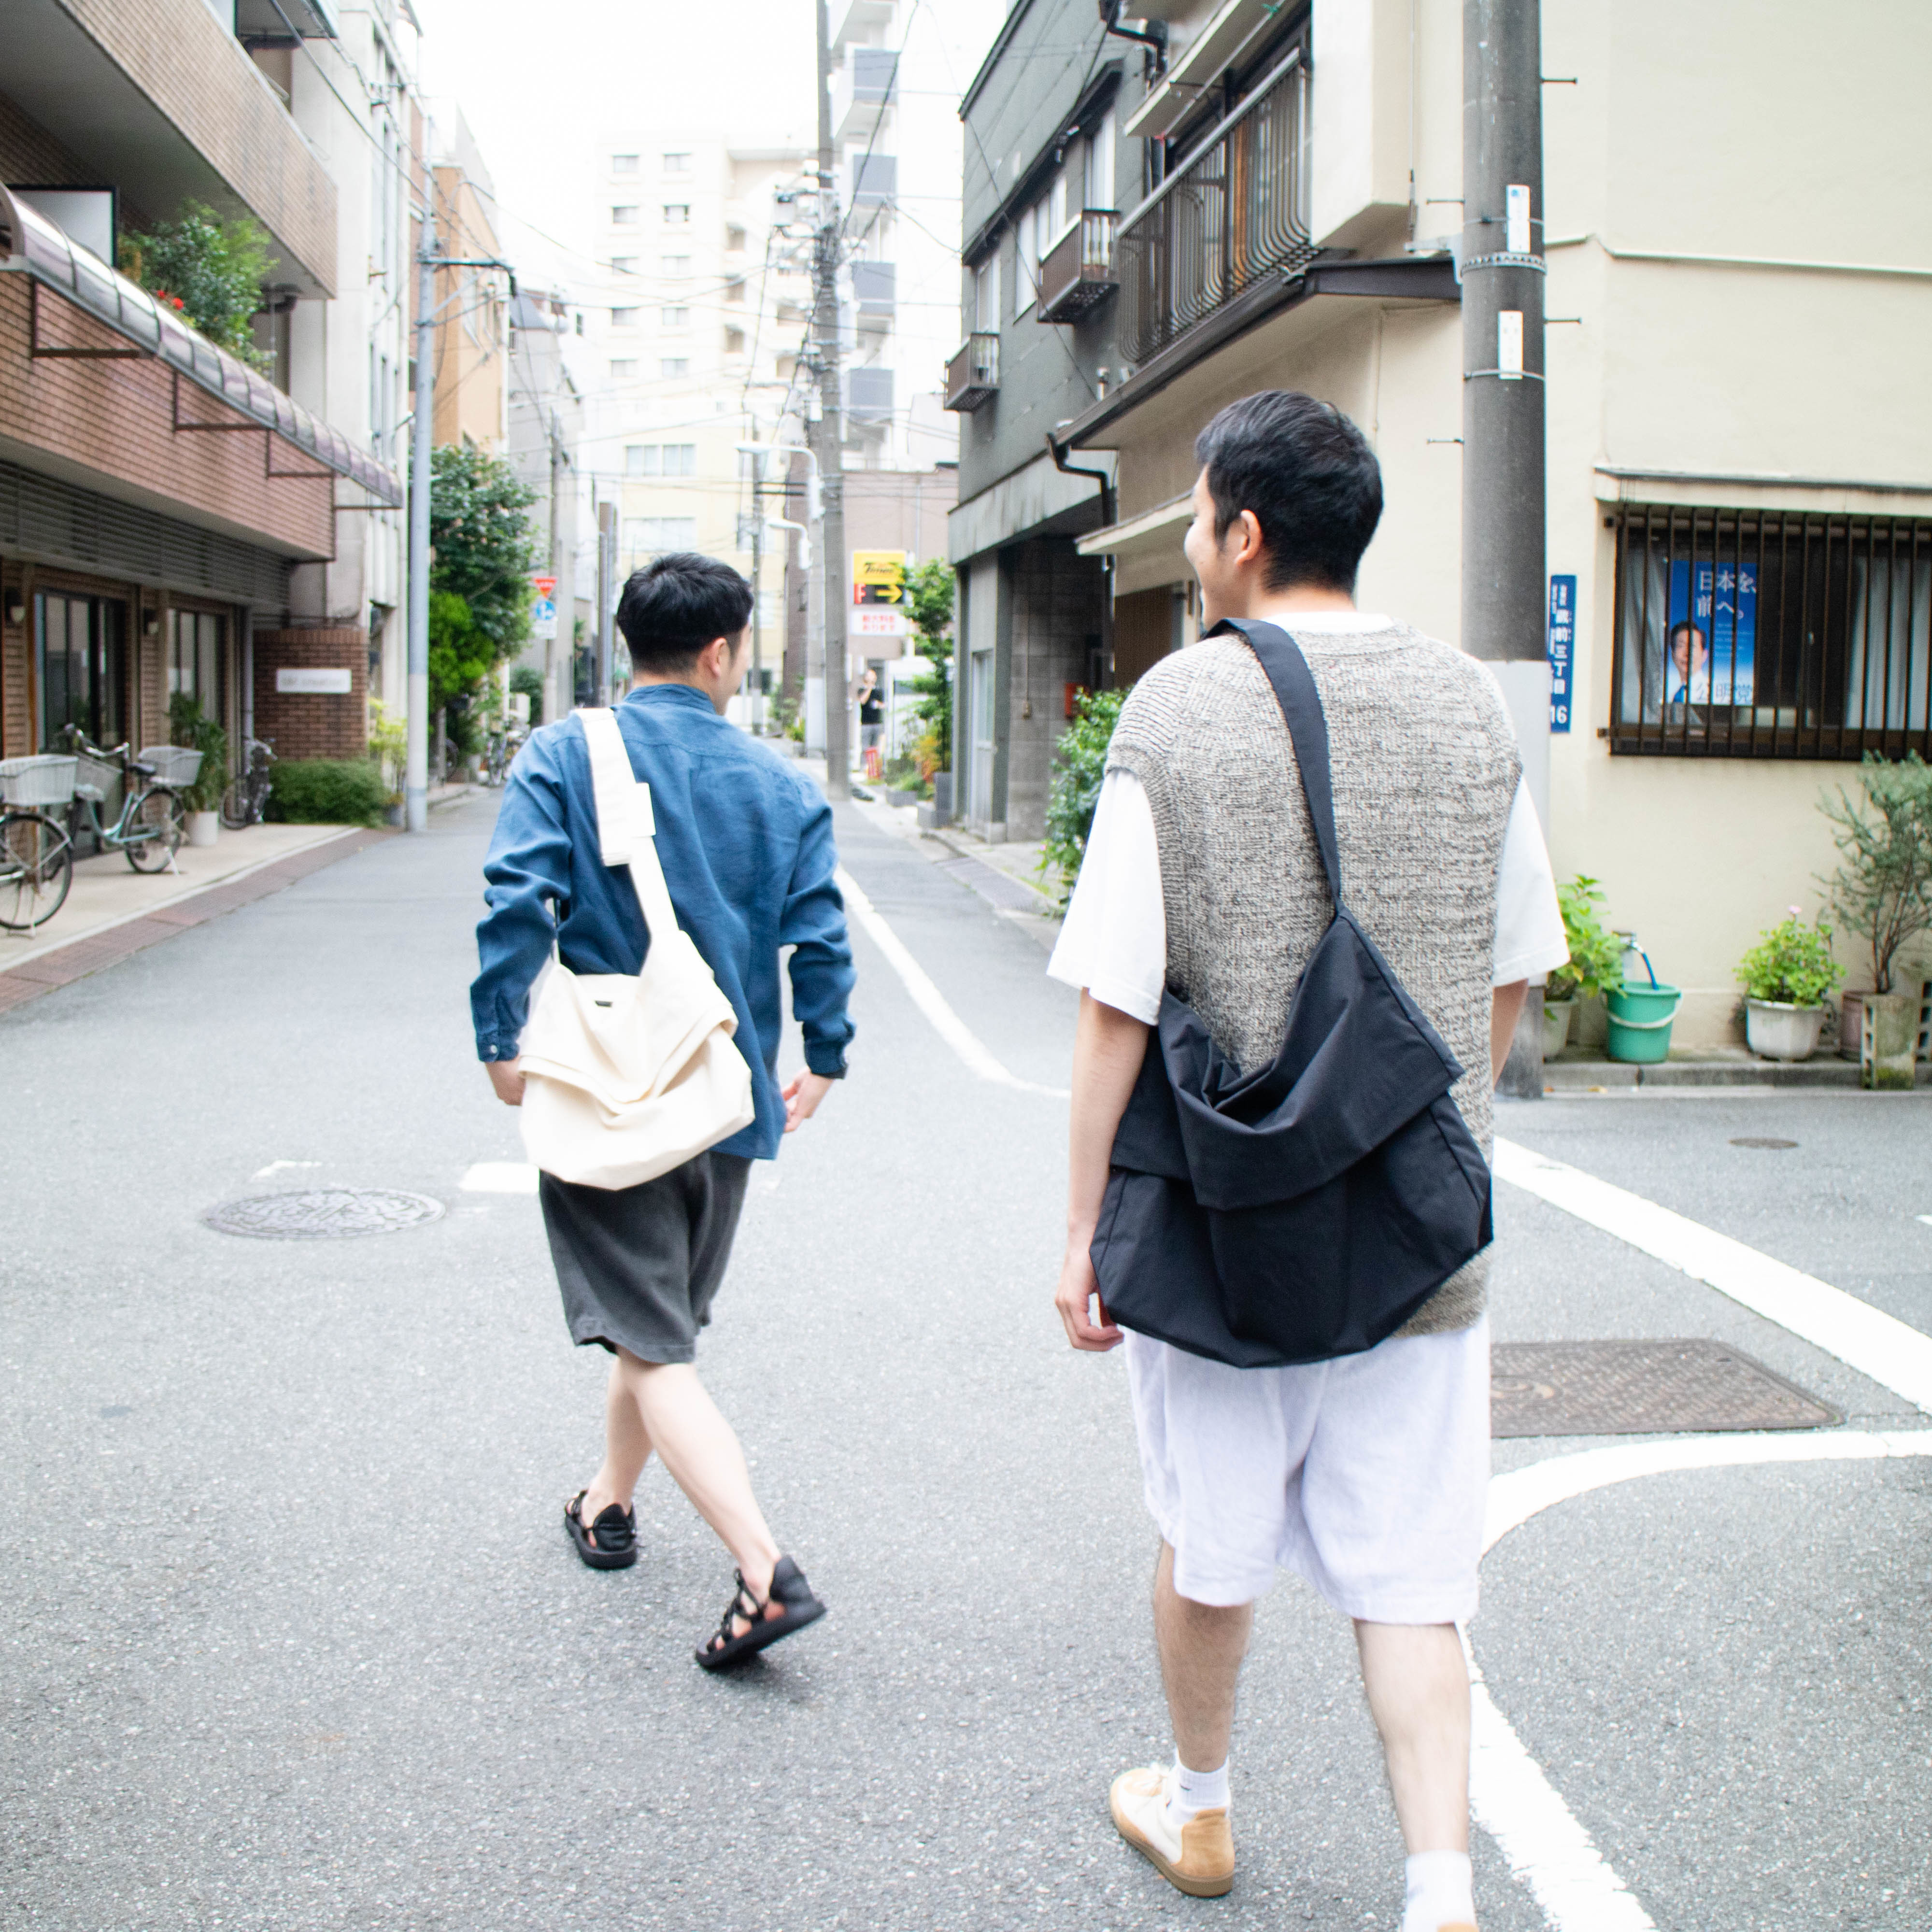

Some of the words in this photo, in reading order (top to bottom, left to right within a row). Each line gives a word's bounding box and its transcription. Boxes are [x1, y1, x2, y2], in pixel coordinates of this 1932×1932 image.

[1700, 570, 1757, 594] 日本を、
[1697, 595, 1744, 620] 前へ。
[1549, 705, 1567, 724] 16
